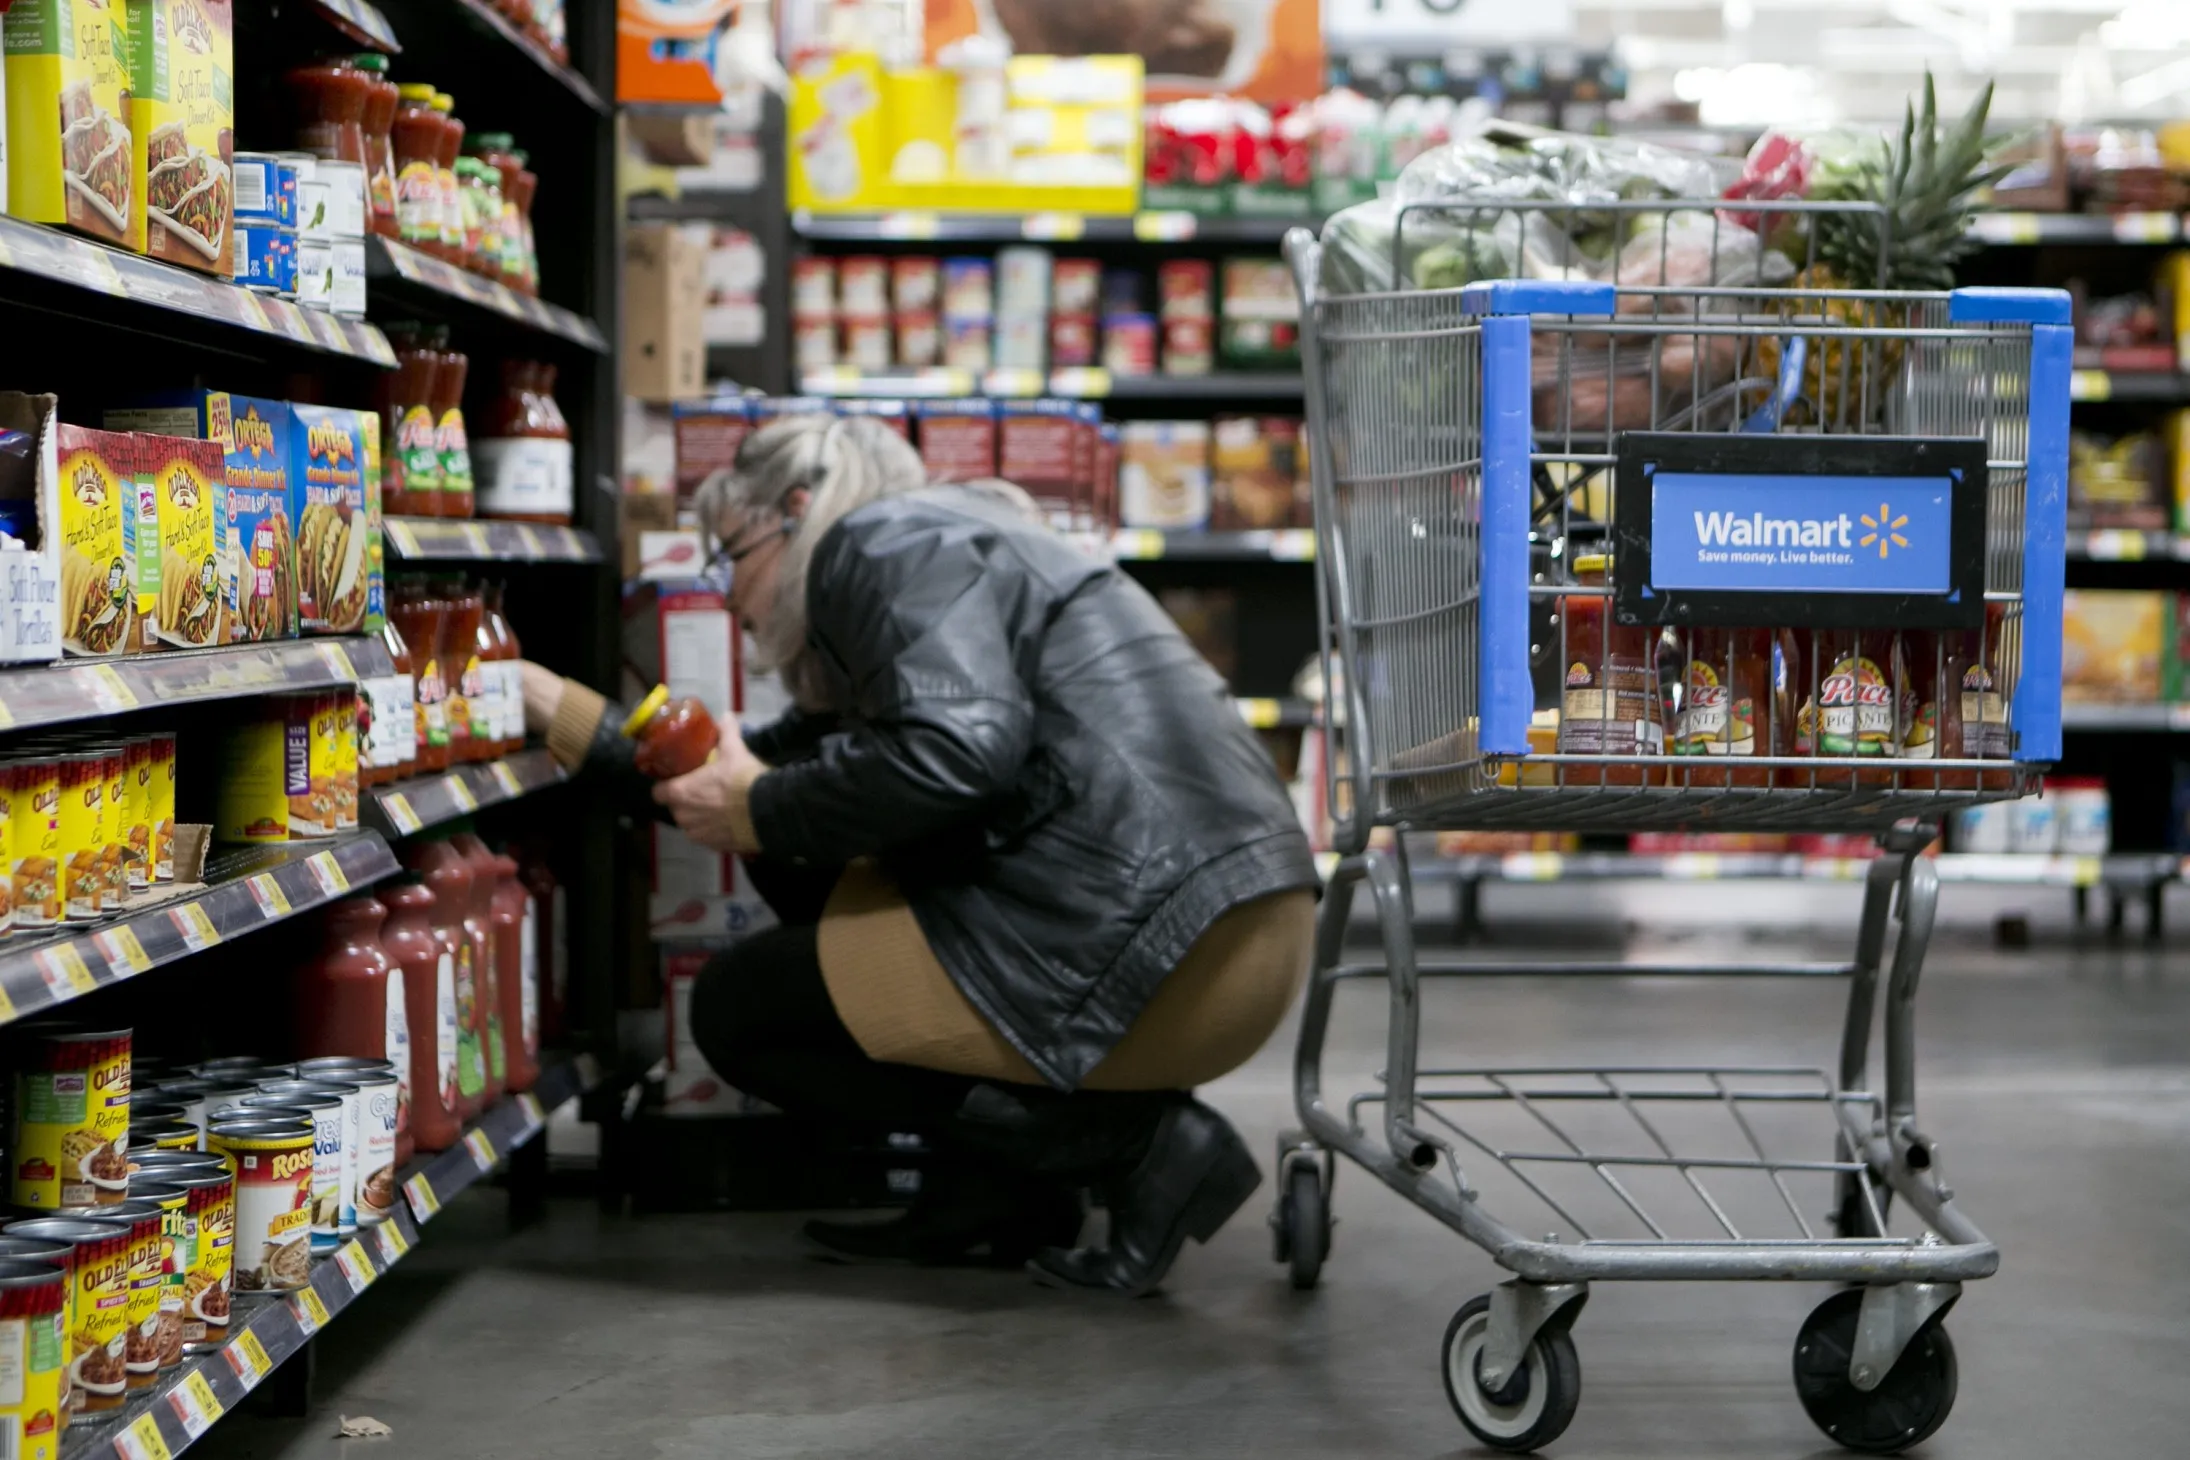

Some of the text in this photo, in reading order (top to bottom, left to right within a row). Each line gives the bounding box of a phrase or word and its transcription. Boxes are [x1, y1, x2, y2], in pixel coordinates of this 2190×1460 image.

[257, 530, 274, 549] SAVE
[1694, 511, 1853, 547] Walmart
[1698, 549, 1854, 565] Save money. Live better.
[1819, 674, 1892, 707] Pace
[289, 738, 307, 792] VALUE
[93, 1065, 119, 1091] OLD
[94, 1110, 127, 1131] Refried
[202, 1210, 222, 1233] OLD
[83, 1265, 113, 1292] OLD
[84, 1311, 121, 1334] Refried
